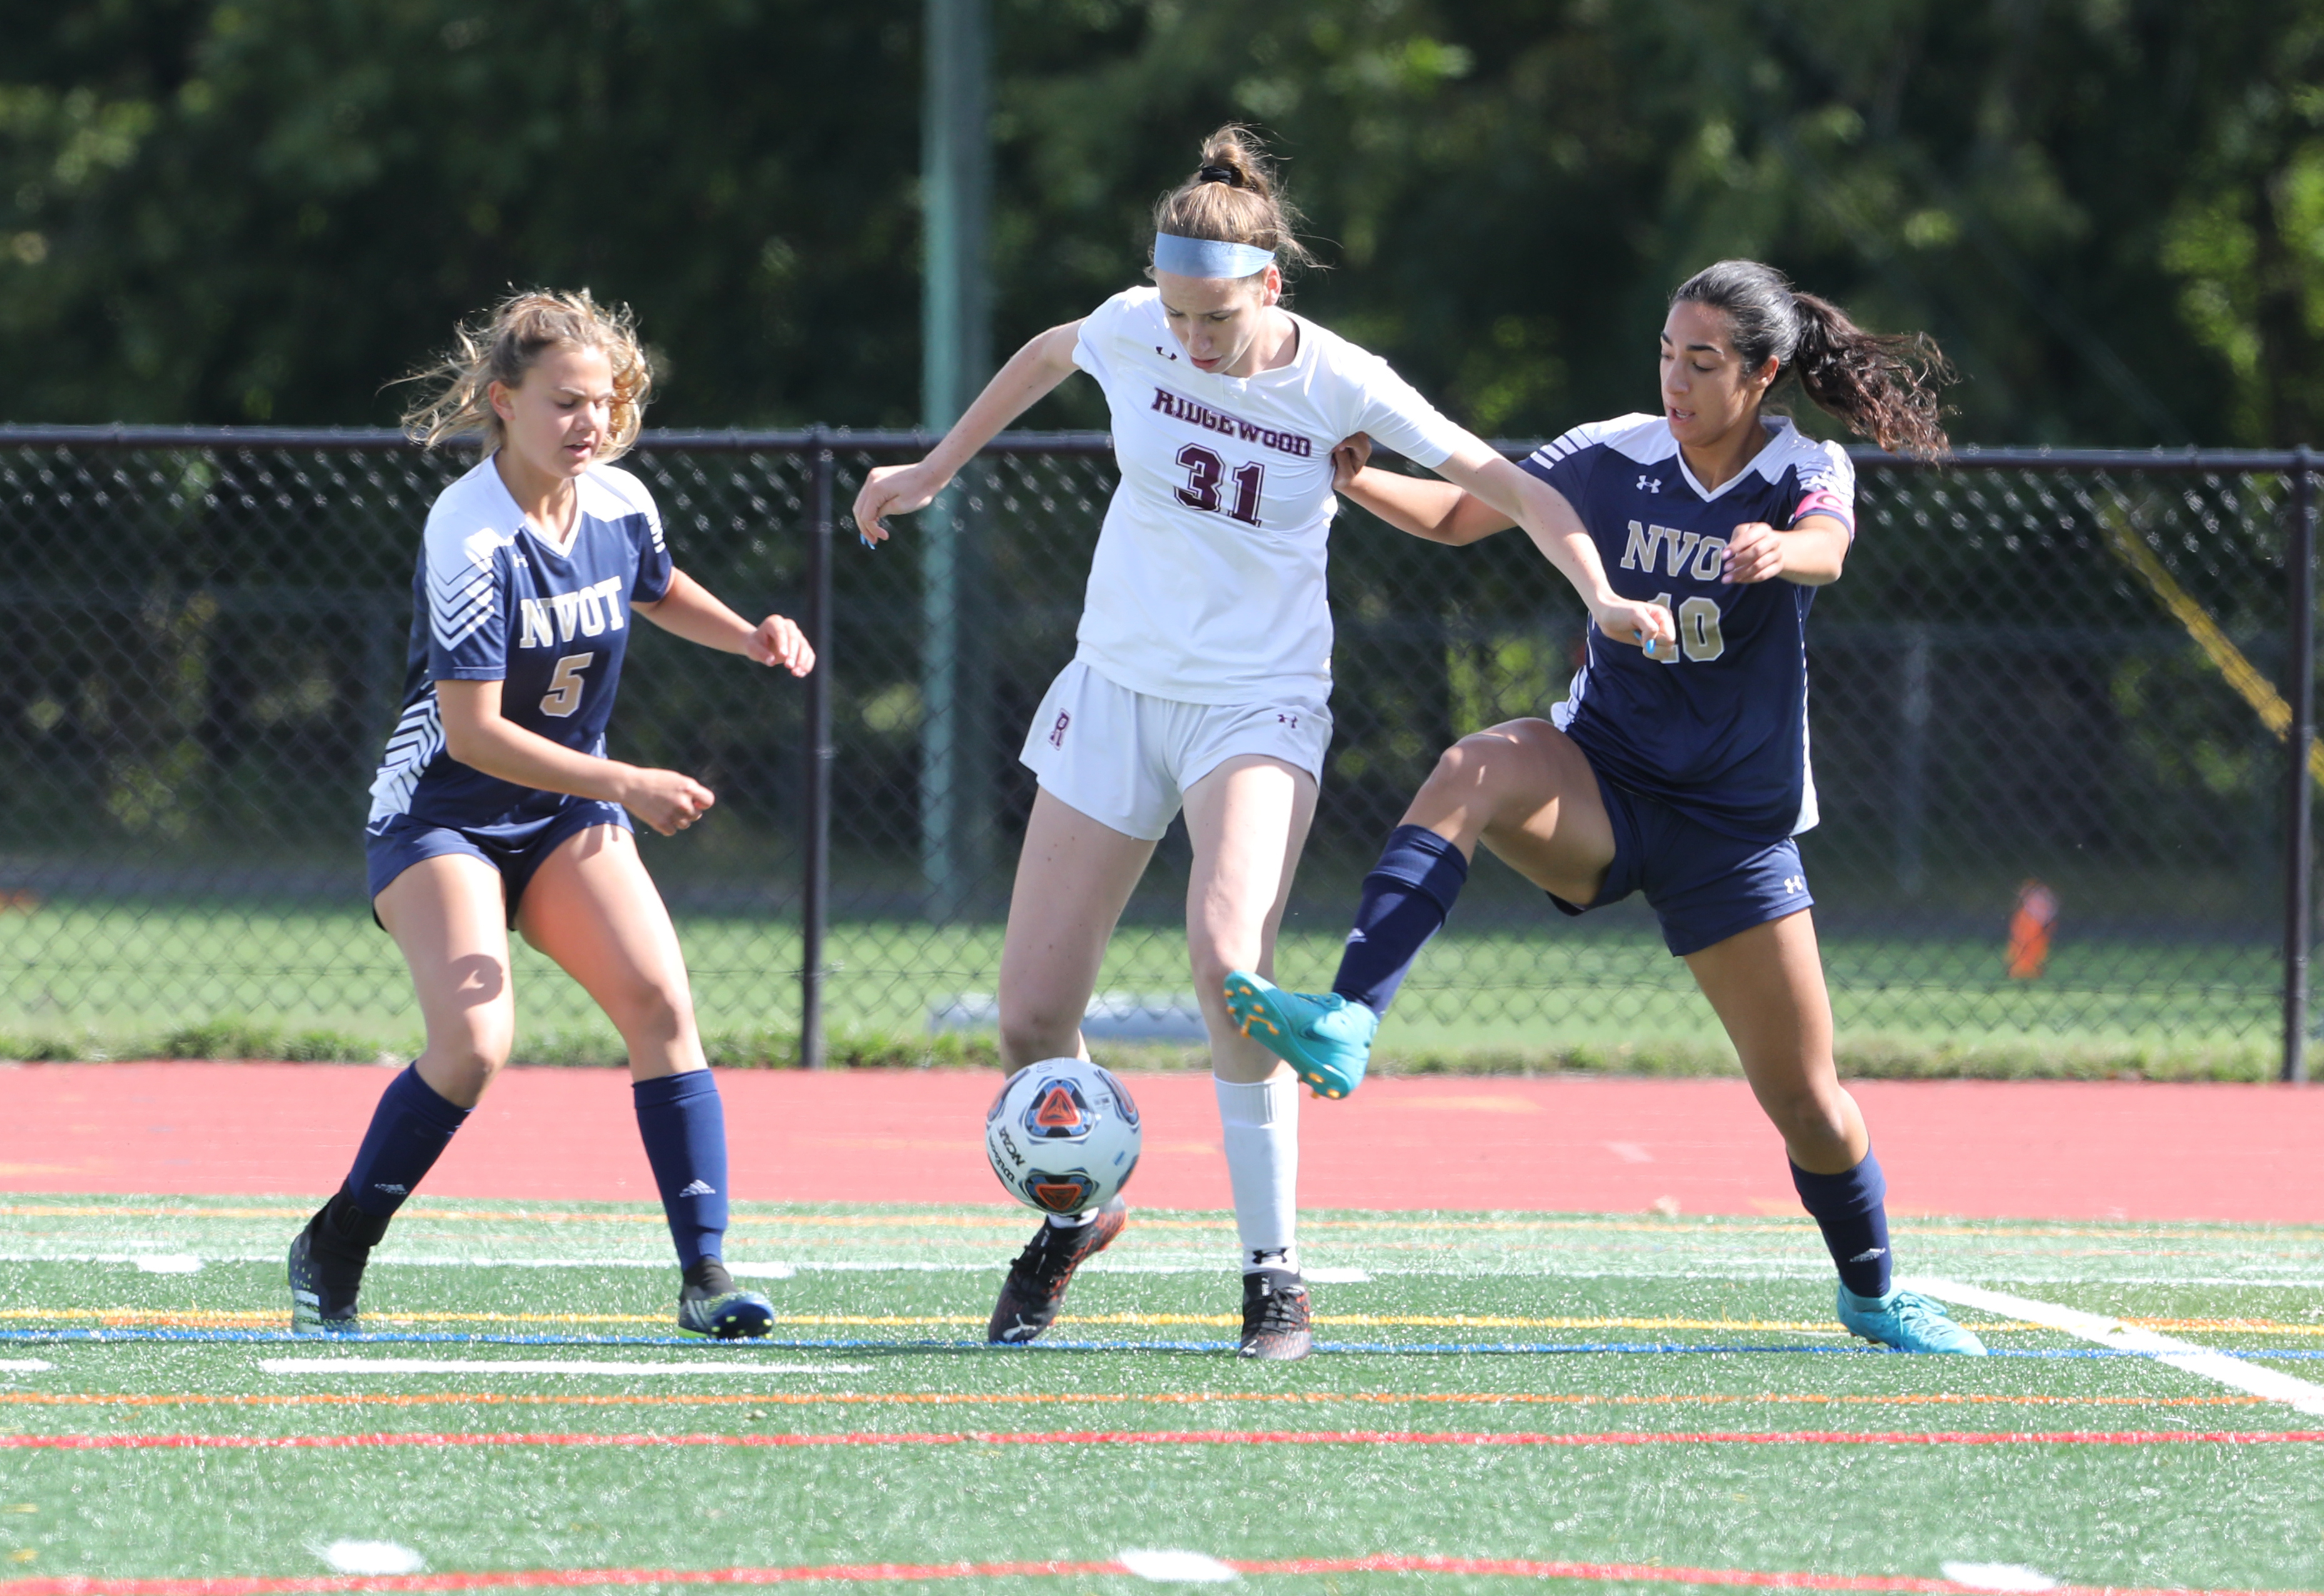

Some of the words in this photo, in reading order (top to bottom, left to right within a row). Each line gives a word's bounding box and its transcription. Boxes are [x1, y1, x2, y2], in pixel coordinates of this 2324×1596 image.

[1151, 387, 1312, 457] RIDGEWOOD
[1173, 442, 1265, 528] 31
[1620, 519, 1727, 581] NVO
[519, 576, 624, 649] NVOT
[539, 652, 594, 717] 5
[1048, 707, 1071, 751] R
[989, 1135, 1016, 1185] Wilson
[998, 1125, 1026, 1167] NCAA
